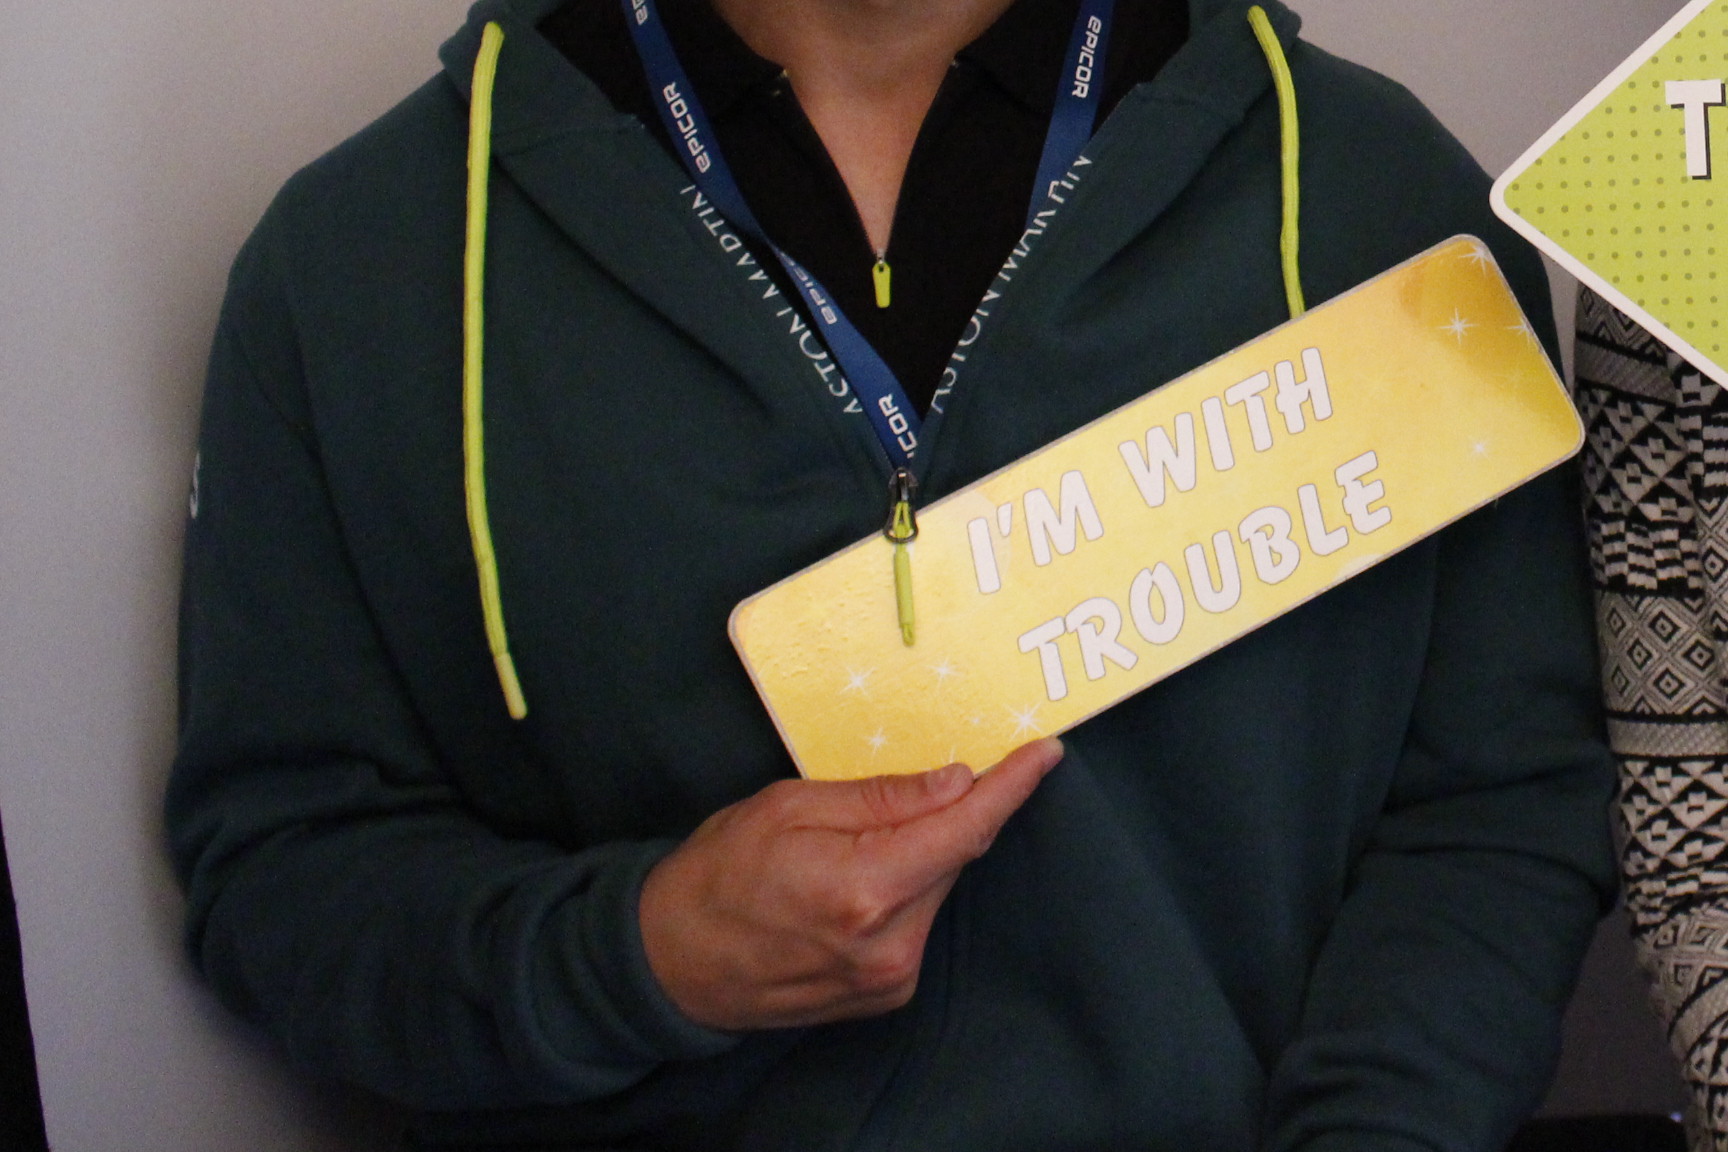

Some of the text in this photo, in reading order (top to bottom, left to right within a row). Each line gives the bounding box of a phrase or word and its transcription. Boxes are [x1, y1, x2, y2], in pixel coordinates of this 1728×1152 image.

[966, 347, 1333, 594] I'M WITH
[1018, 450, 1392, 702] TROUBLE
